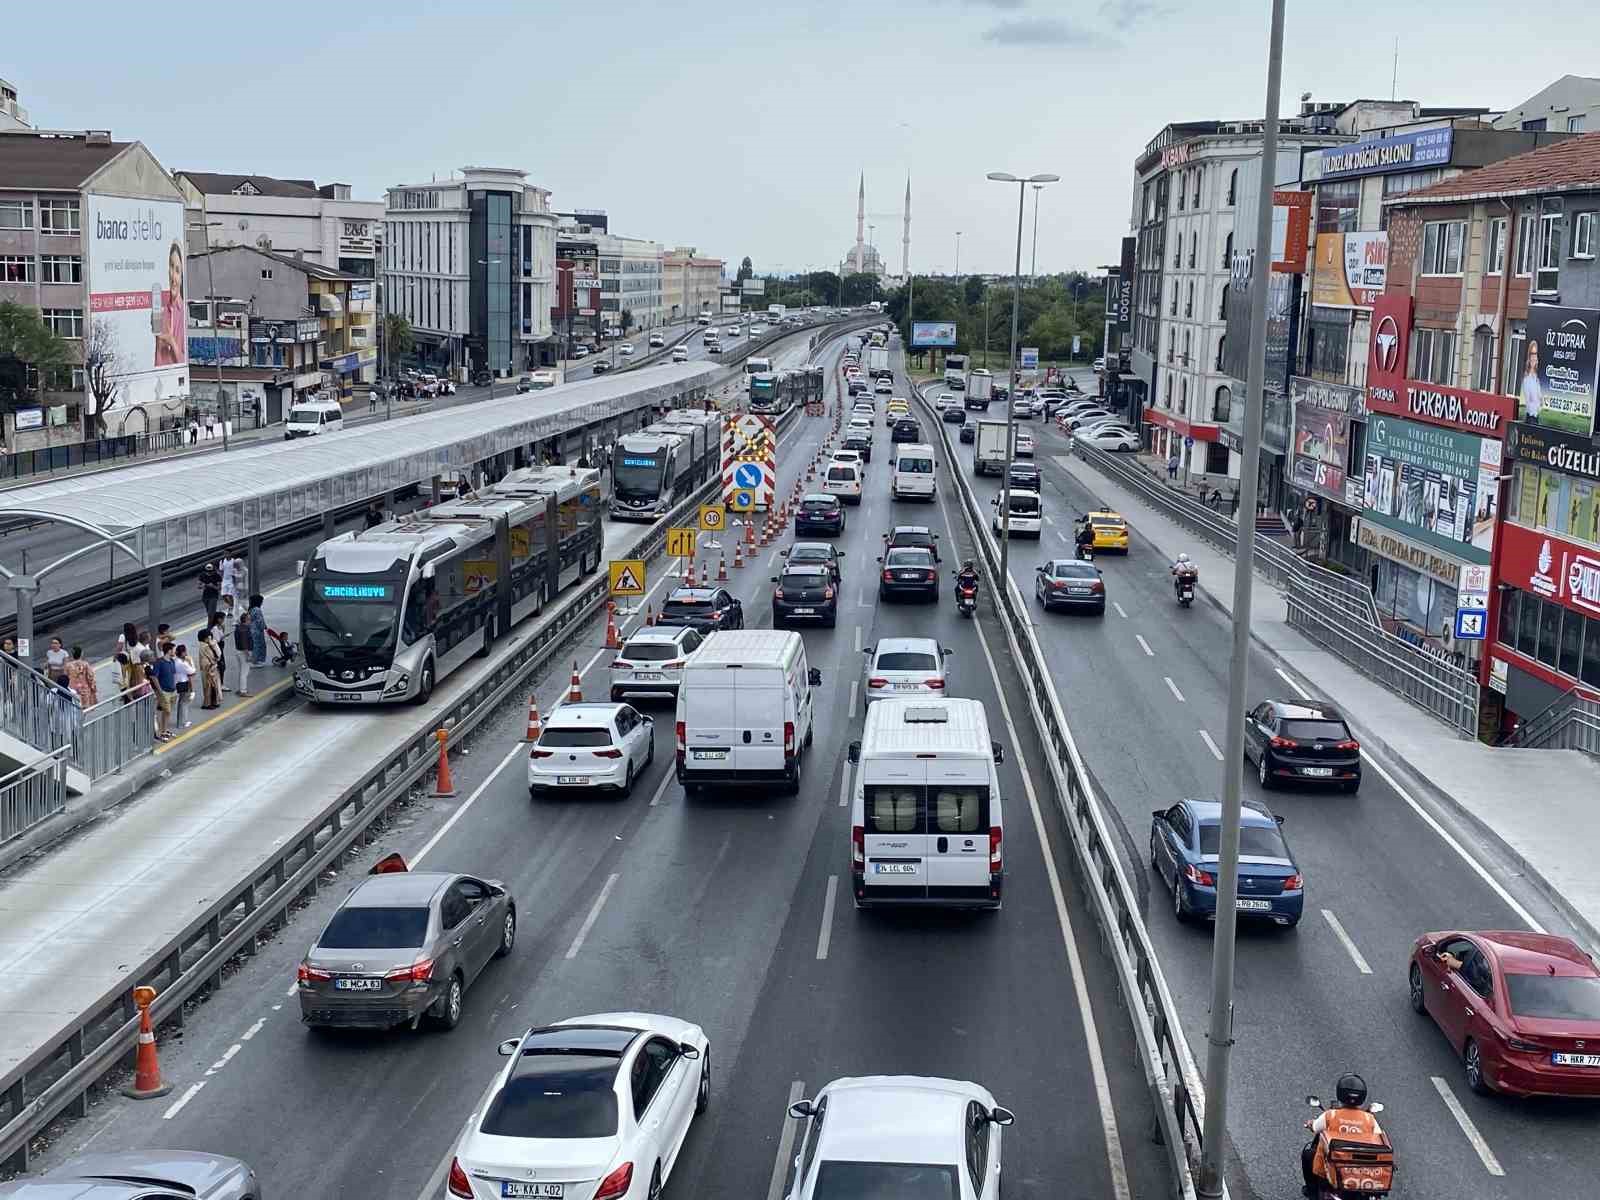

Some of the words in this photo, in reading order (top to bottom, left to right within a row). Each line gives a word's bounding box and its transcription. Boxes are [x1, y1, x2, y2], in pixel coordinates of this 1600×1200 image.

[1161, 144, 1190, 168] AKBANK
[1380, 144, 1412, 165] SALONU
[96, 210, 128, 240] bianca
[132, 208, 162, 241] stella
[344, 222, 368, 237] E&G
[1546, 329, 1556, 346] ÖZ
[1557, 332, 1587, 350] TOPRAK
[708, 514, 718, 523] 30
[350, 980, 368, 988] MCA
[1558, 1054, 1567, 1063] 34
[1570, 1054, 1584, 1065] HKR
[1343, 1167, 1383, 1178] trendyol
[508, 1183, 519, 1194] 34
[523, 1184, 540, 1195] KXA
[544, 1185, 561, 1196] 402
